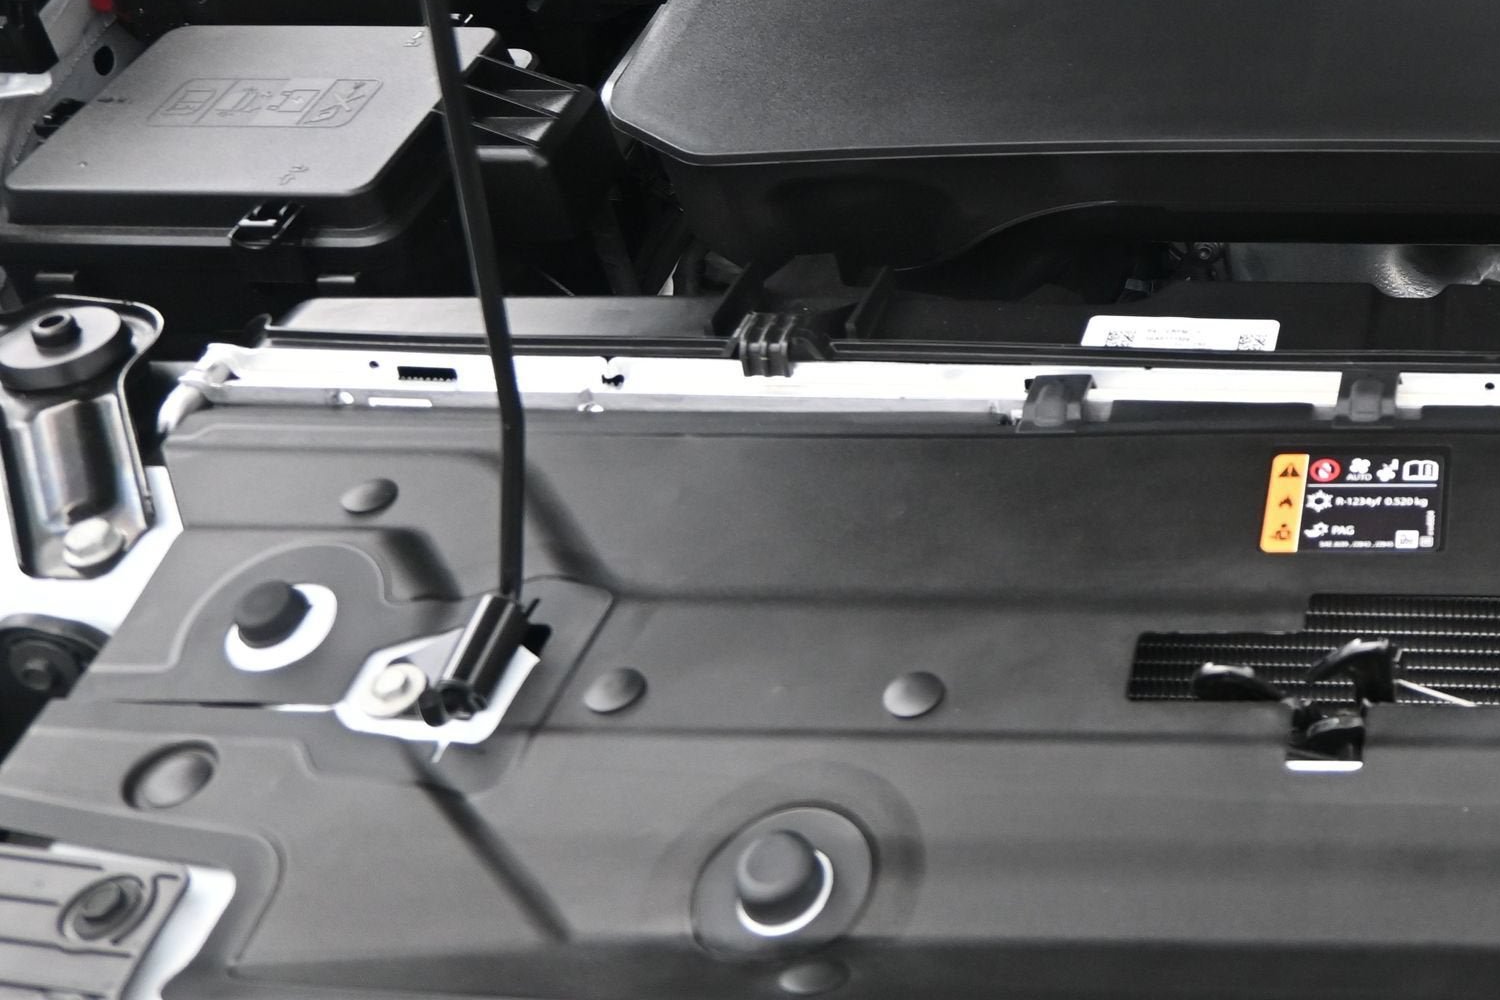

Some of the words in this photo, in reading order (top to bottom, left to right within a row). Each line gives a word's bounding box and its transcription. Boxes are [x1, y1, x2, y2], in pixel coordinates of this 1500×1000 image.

[1336, 497, 1381, 507] R-1234yf
[1414, 497, 1428, 507] kg
[1332, 526, 1354, 535] PAG
